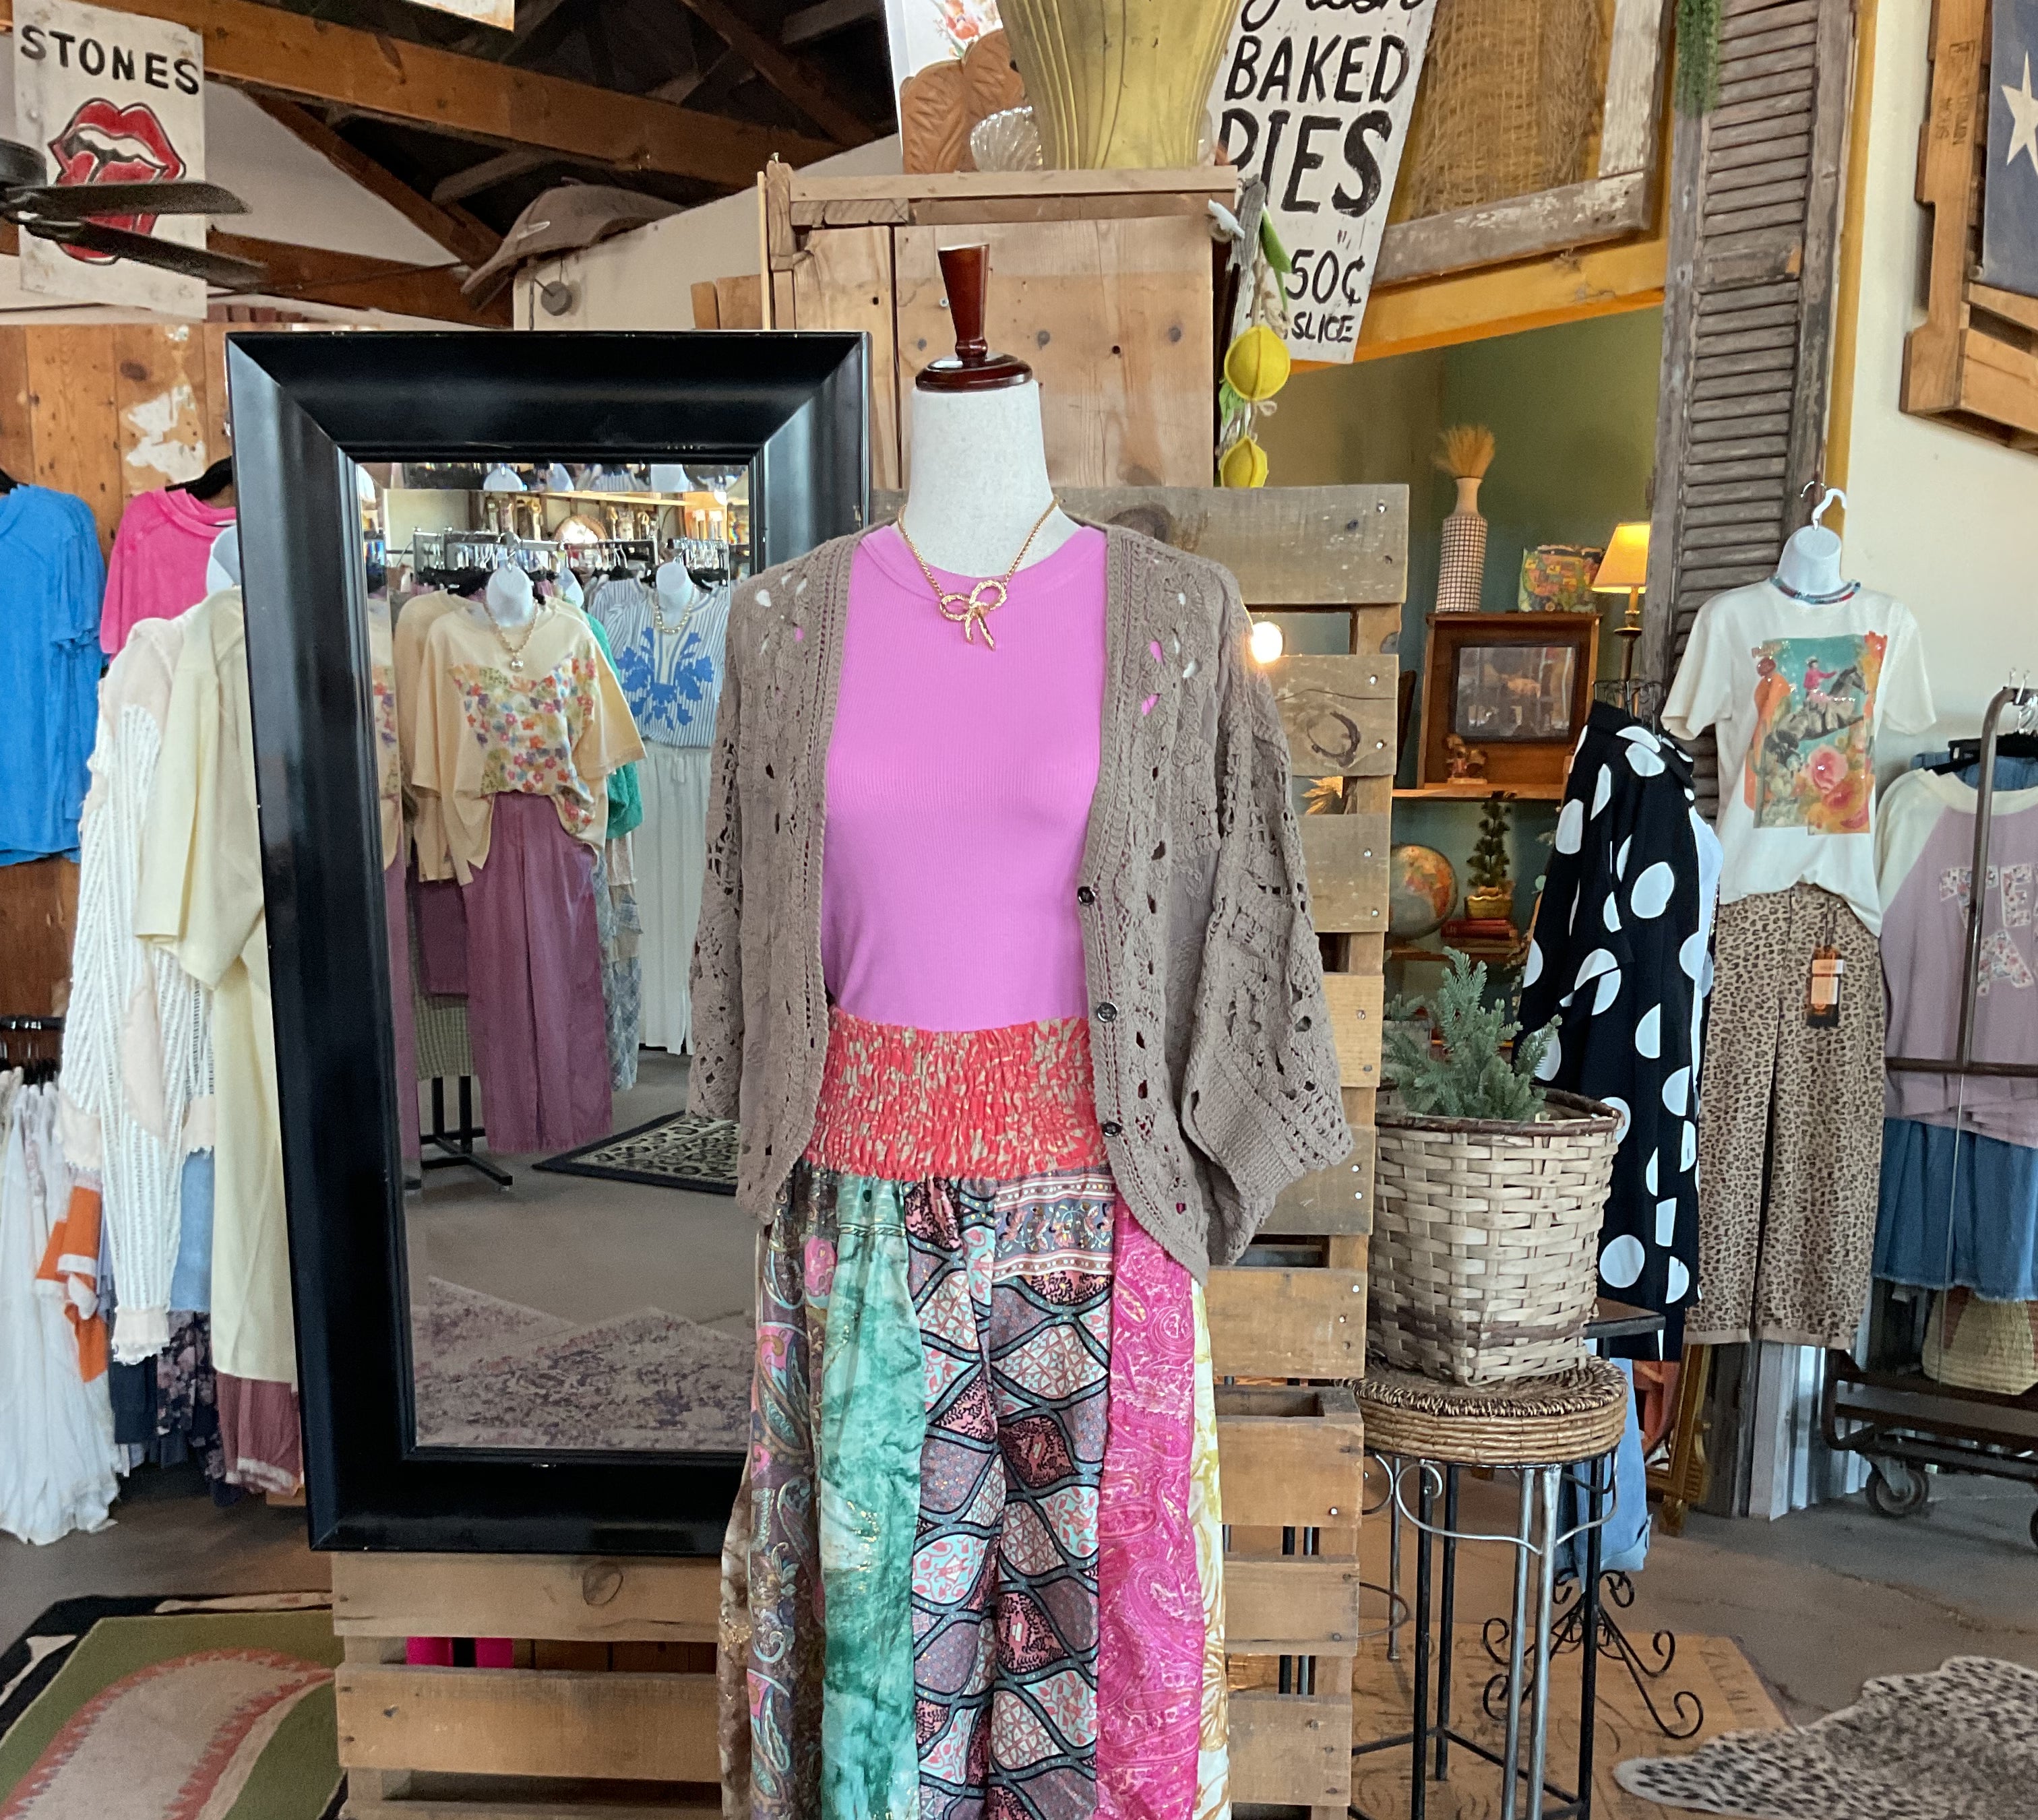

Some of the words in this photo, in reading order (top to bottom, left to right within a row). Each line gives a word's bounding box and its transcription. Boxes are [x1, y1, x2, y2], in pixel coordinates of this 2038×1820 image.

[20, 25, 199, 95] STONES
[1225, 34, 1410, 103] BAKED
[1285, 249, 1365, 307] 50¢
[1291, 311, 1355, 344] SLICE
[1939, 863, 2038, 934] TE
